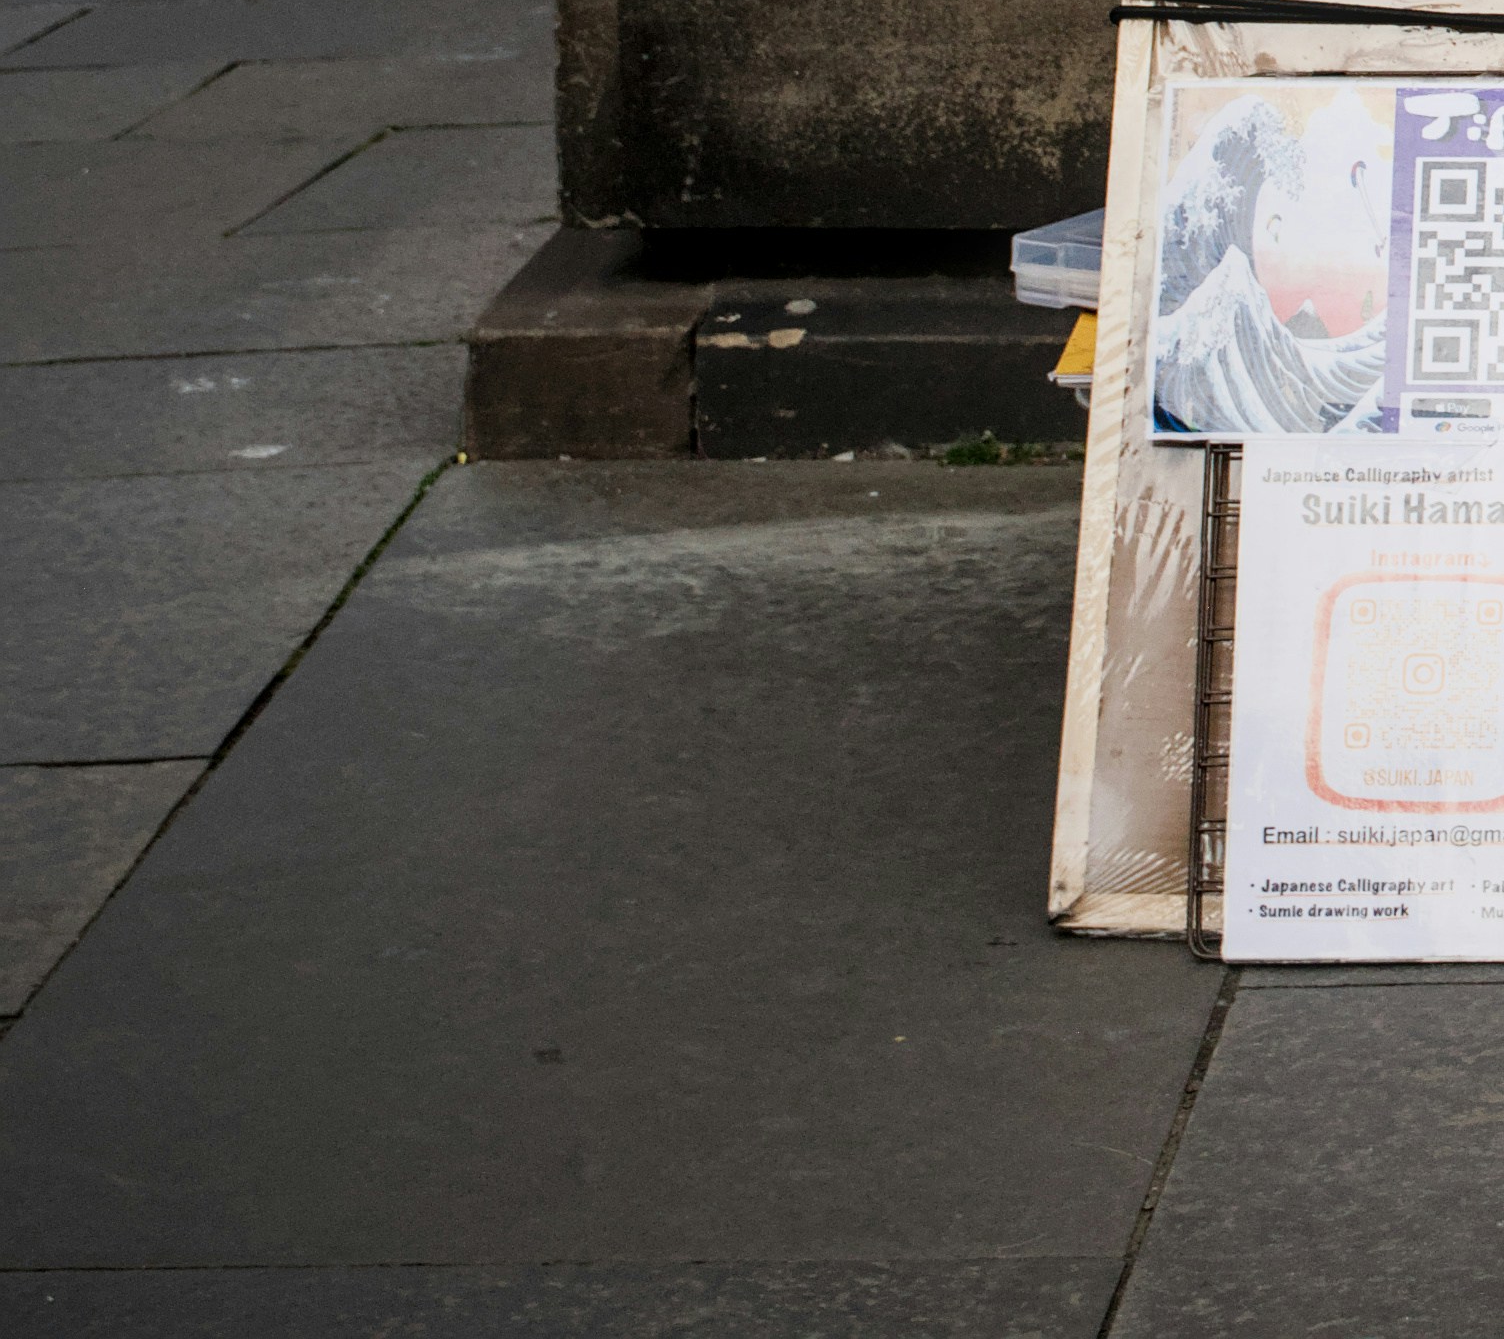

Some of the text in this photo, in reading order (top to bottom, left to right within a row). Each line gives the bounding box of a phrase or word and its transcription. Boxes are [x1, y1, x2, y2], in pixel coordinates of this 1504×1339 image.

[1456, 422, 1495, 435] Google
[1344, 467, 1442, 487] Calligraphy
[1301, 493, 1392, 526] Suiki
[1370, 549, 1475, 570] Instagram
[1363, 769, 1475, 788] @SUIKI.JAPAN
[1262, 825, 1322, 845] Email
[1260, 877, 1456, 896] Japanese Calligraphy art
[1307, 903, 1369, 921] drawing
[1372, 902, 1410, 919] work
